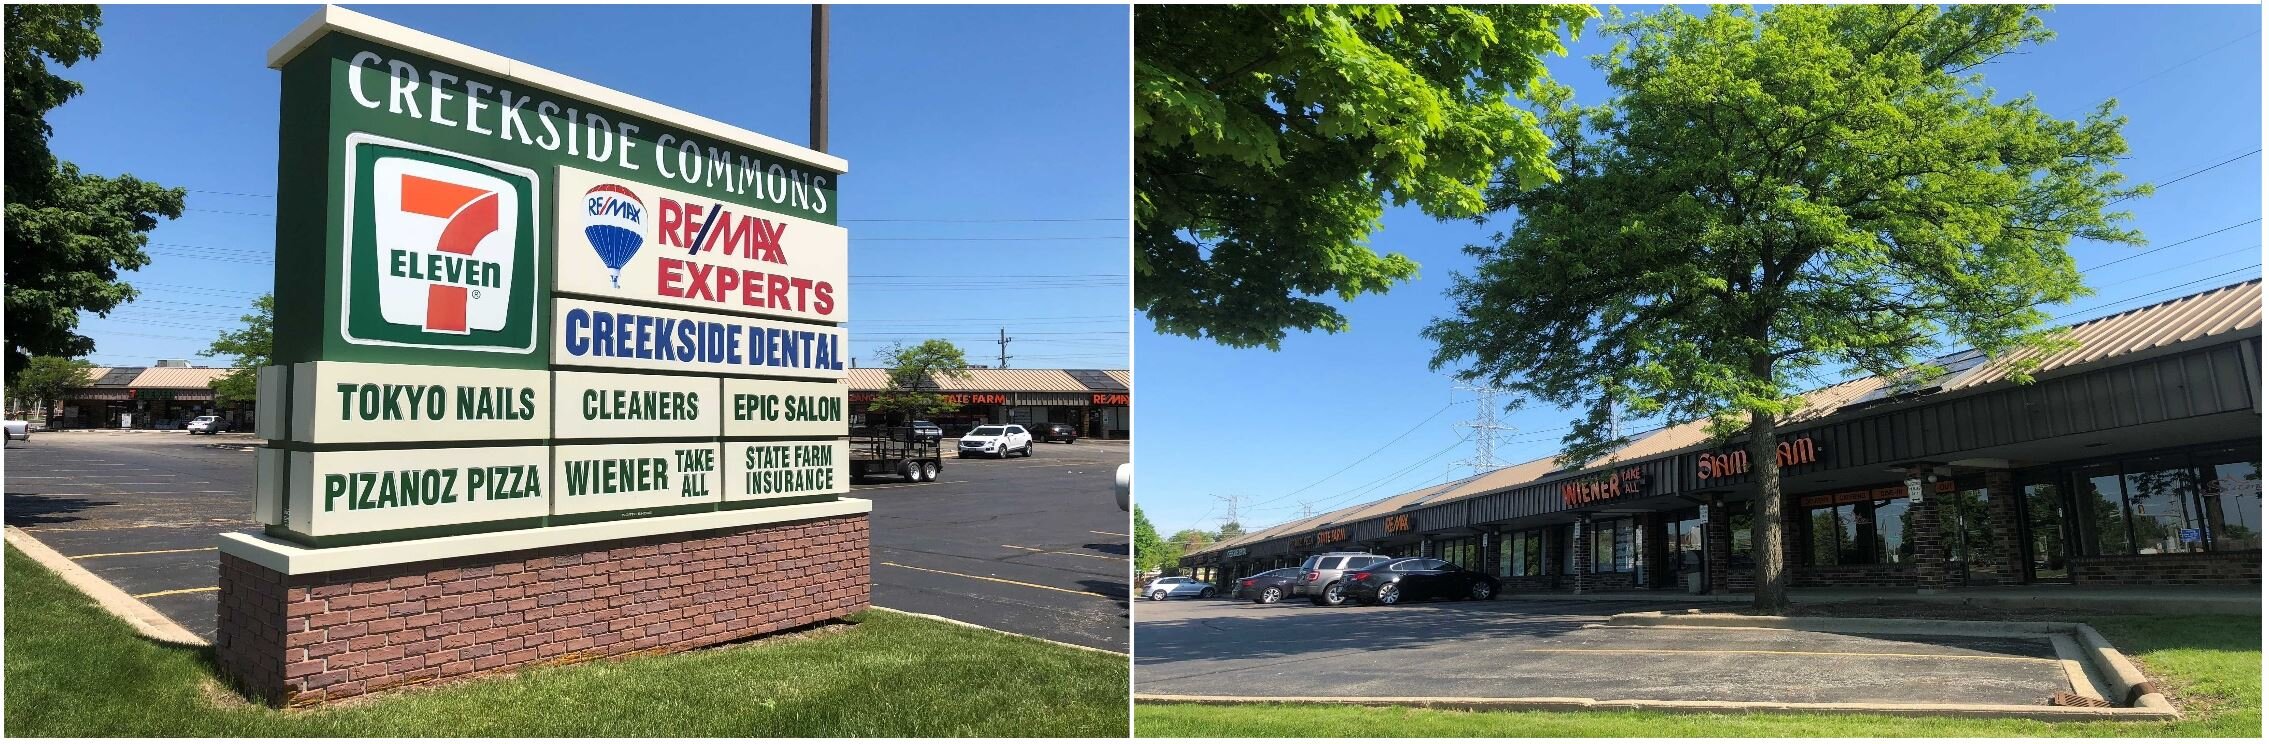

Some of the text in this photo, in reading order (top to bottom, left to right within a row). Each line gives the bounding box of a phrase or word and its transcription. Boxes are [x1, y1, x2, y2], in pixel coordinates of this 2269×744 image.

[348, 51, 827, 213] CREEKSIDE COMMONS
[588, 197, 641, 225] RE/MAX
[658, 197, 788, 265] RE/MAX
[657, 257, 835, 316] EXPERTS
[565, 308, 844, 371] CREEKSIDE DENTAL
[337, 383, 536, 421] TOKYO NAILS
[582, 388, 699, 421] CLEANERS
[733, 393, 841, 422] EPIC SALON
[972, 394, 1005, 404] FARM
[675, 448, 714, 473] TAKE
[745, 445, 833, 470] STATE FARM
[1622, 465, 1641, 481] TAKE
[1698, 449, 1749, 480] SIAM
[324, 465, 542, 513] PIZANOZ PIZZA
[565, 457, 670, 496] WIENER
[681, 473, 709, 498] ALL
[746, 468, 834, 494] INSURANCE
[1562, 473, 1621, 505] WIENER
[1625, 480, 1640, 493] ALL
